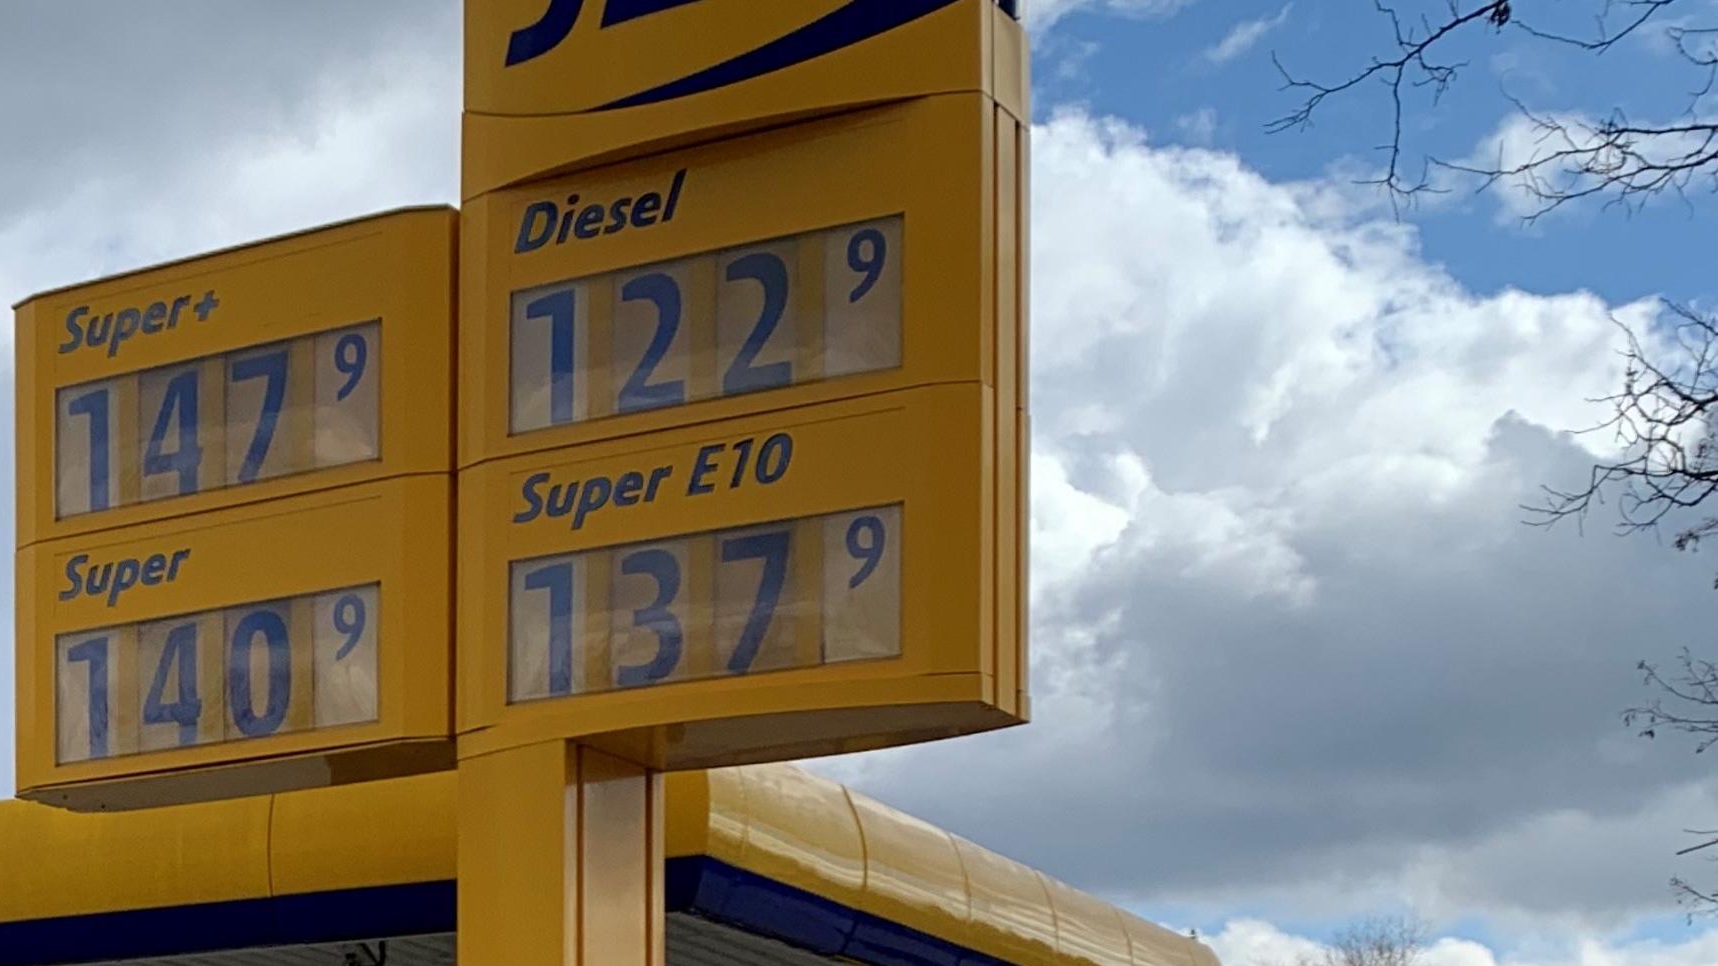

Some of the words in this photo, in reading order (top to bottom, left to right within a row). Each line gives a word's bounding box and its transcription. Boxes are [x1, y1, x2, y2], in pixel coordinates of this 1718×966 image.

[514, 168, 687, 254] Diesel
[58, 290, 220, 359] Super+
[512, 464, 673, 531] Super
[686, 432, 794, 497] E10
[58, 548, 191, 607] Super
